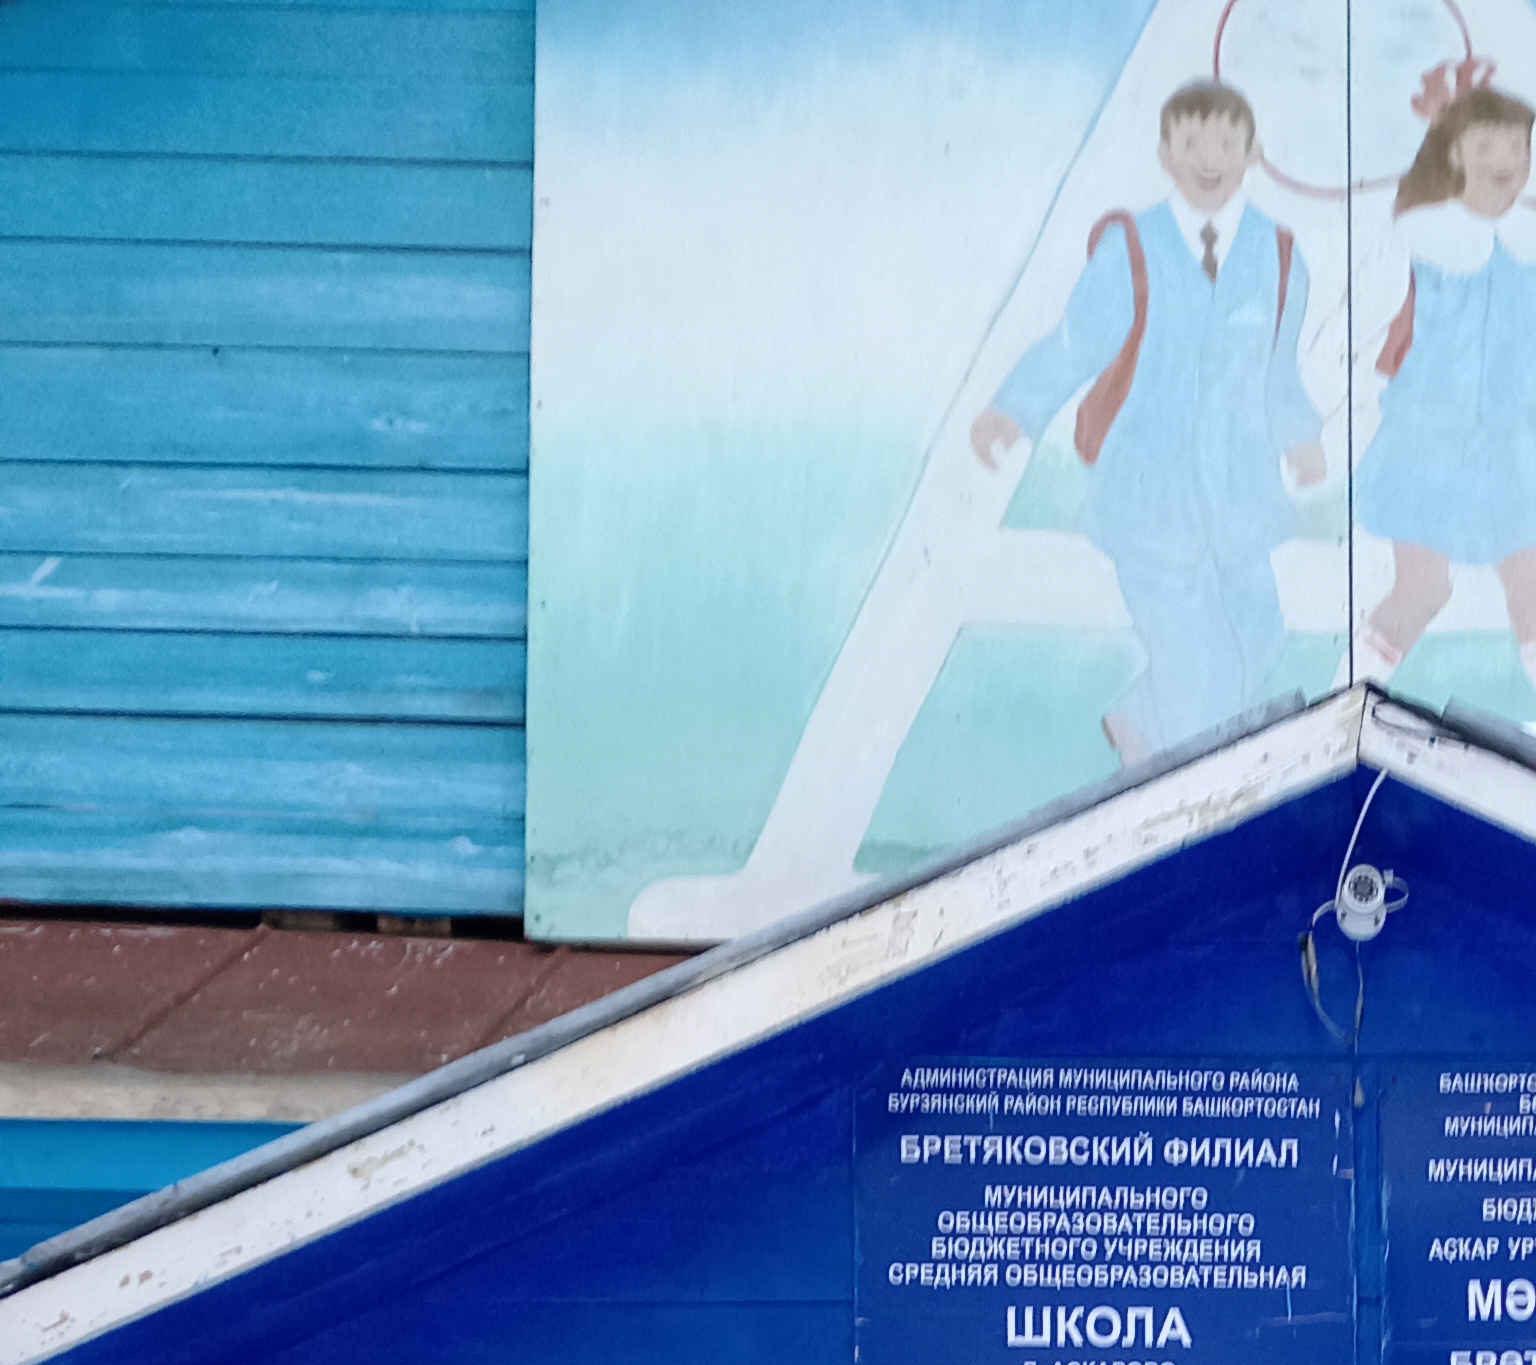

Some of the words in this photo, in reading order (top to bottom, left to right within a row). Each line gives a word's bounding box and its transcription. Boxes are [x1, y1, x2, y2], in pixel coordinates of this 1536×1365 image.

[901, 1068, 1054, 1091] АДМИНИСТРАЦИЯ
[1059, 1069, 1224, 1091] МУНИЦИПАЛЬНОГО
[1230, 1069, 1299, 1093] РАЙОНА
[888, 1091, 998, 1113] БУРЗЯНСКИЙ
[1004, 1093, 1061, 1115] РАЙОН
[1066, 1095, 1177, 1116] РЕСПУБЛИКИ
[1183, 1097, 1320, 1118] БАШКОРТОСТАН
[901, 1132, 1153, 1165] БРЕТЯКОВСКИЙ
[1164, 1138, 1298, 1168] ФИЛИАЛ
[984, 1185, 1207, 1211] МУНИЦИПАЛЬНОГО
[937, 1211, 1254, 1236] ОБЩЕОБРАЗОВАТЕЛЬНОГО
[931, 1237, 1097, 1262] БЮДЖЕТНОГО
[1103, 1239, 1262, 1265] УЧРЕЖДЕНИЯ
[889, 1263, 998, 1289] СРЕДНЯЯ
[1006, 1265, 1306, 1290] ОБЩЕОБРАЗОВАТЕЛЬНАЯ
[1007, 1306, 1192, 1348] ШКОЛА
